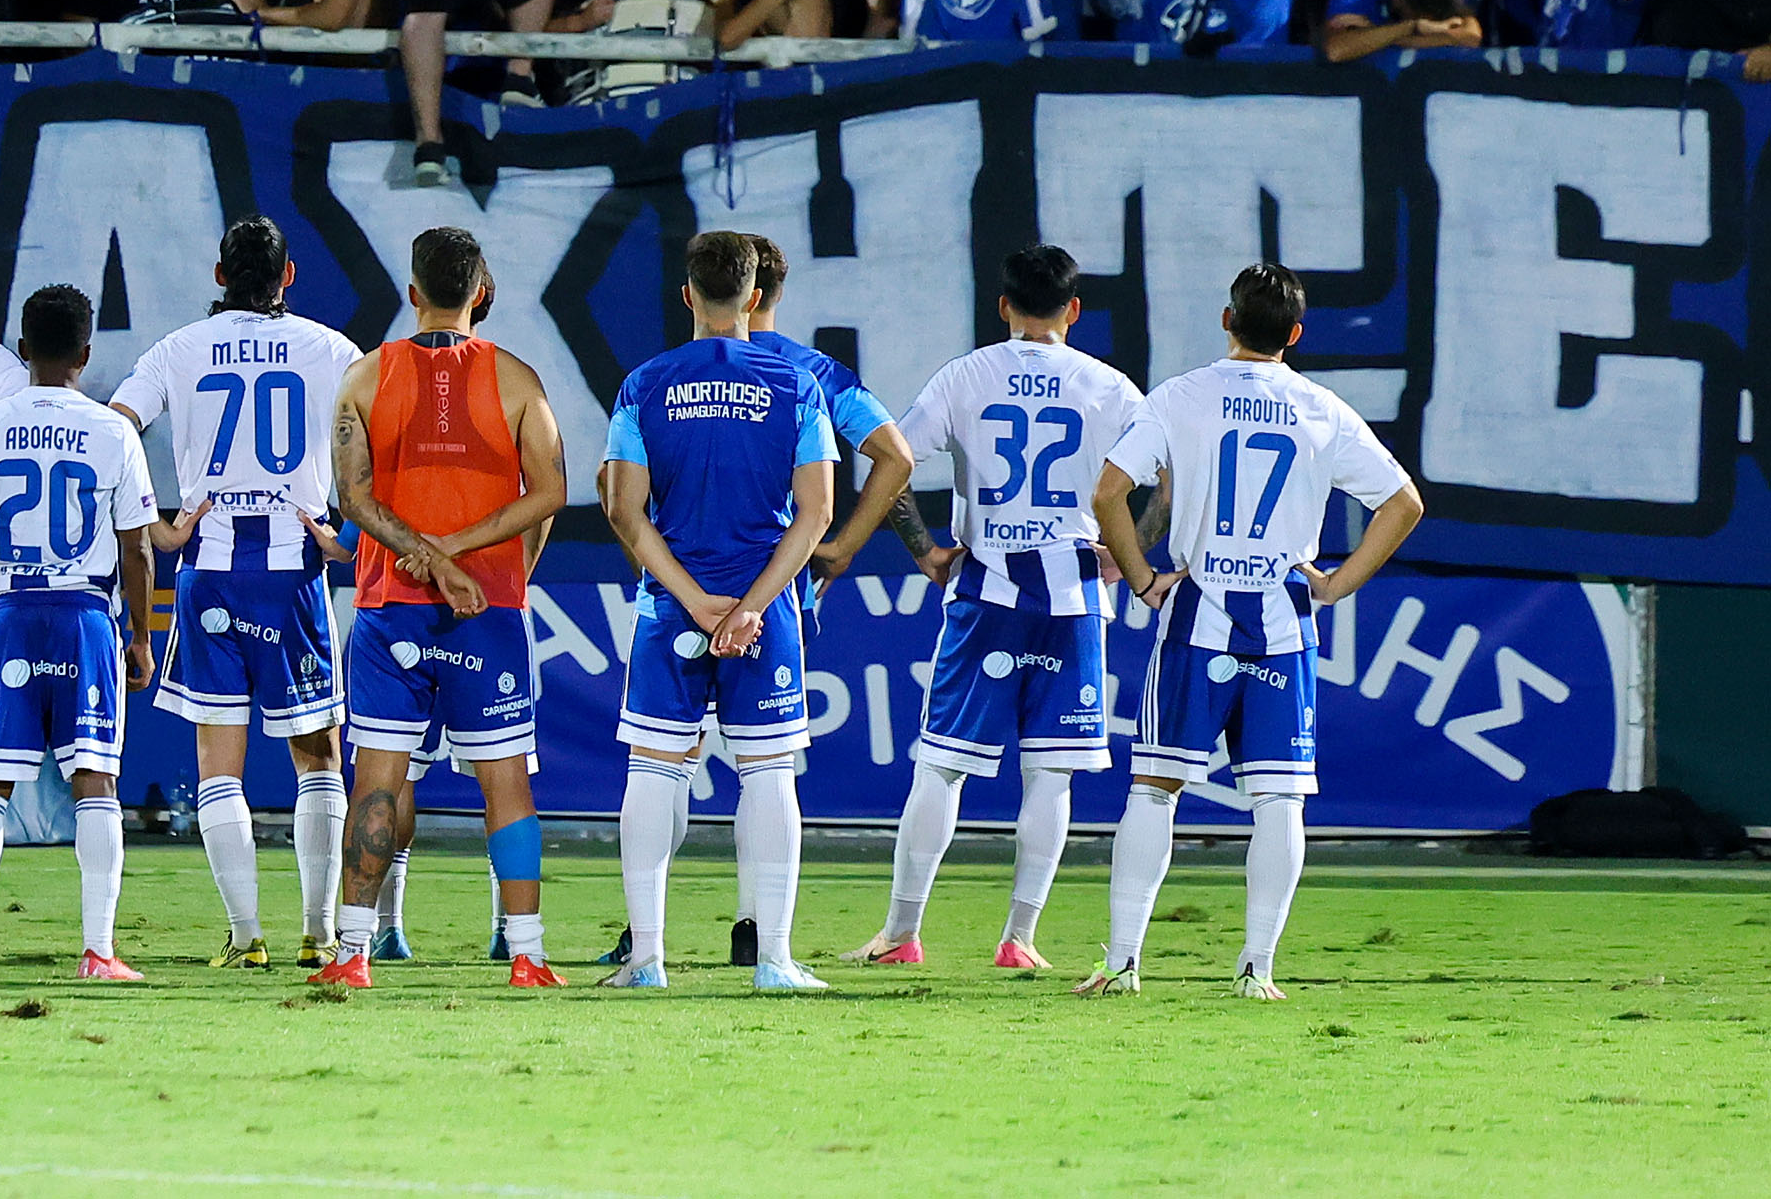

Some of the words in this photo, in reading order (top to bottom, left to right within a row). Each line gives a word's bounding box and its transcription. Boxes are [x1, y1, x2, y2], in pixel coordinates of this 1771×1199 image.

[212, 339, 289, 366] M.ELIA
[664, 381, 772, 408] ANORTHOSIS
[1007, 373, 1061, 399] SOSA
[435, 369, 450, 434] gpexe
[667, 404, 730, 422] FAMAGUSTA
[732, 406, 747, 420] FC
[1222, 396, 1298, 426] PAROUTIS
[196, 370, 306, 477] 70
[5, 425, 90, 454] ABOAGYE
[977, 403, 1084, 508] 32
[1215, 428, 1297, 539] 17
[207, 489, 286, 506] IronFX
[984, 517, 1058, 541] IronFX
[1204, 551, 1279, 578] IronFX
[1203, 576, 1236, 584] SOLID
[262, 627, 281, 645] Oil
[32, 659, 66, 677] Island
[423, 647, 463, 667] Island
[464, 649, 484, 673] Oil
[1044, 656, 1062, 674] Oil
[1268, 671, 1288, 690] Oil
